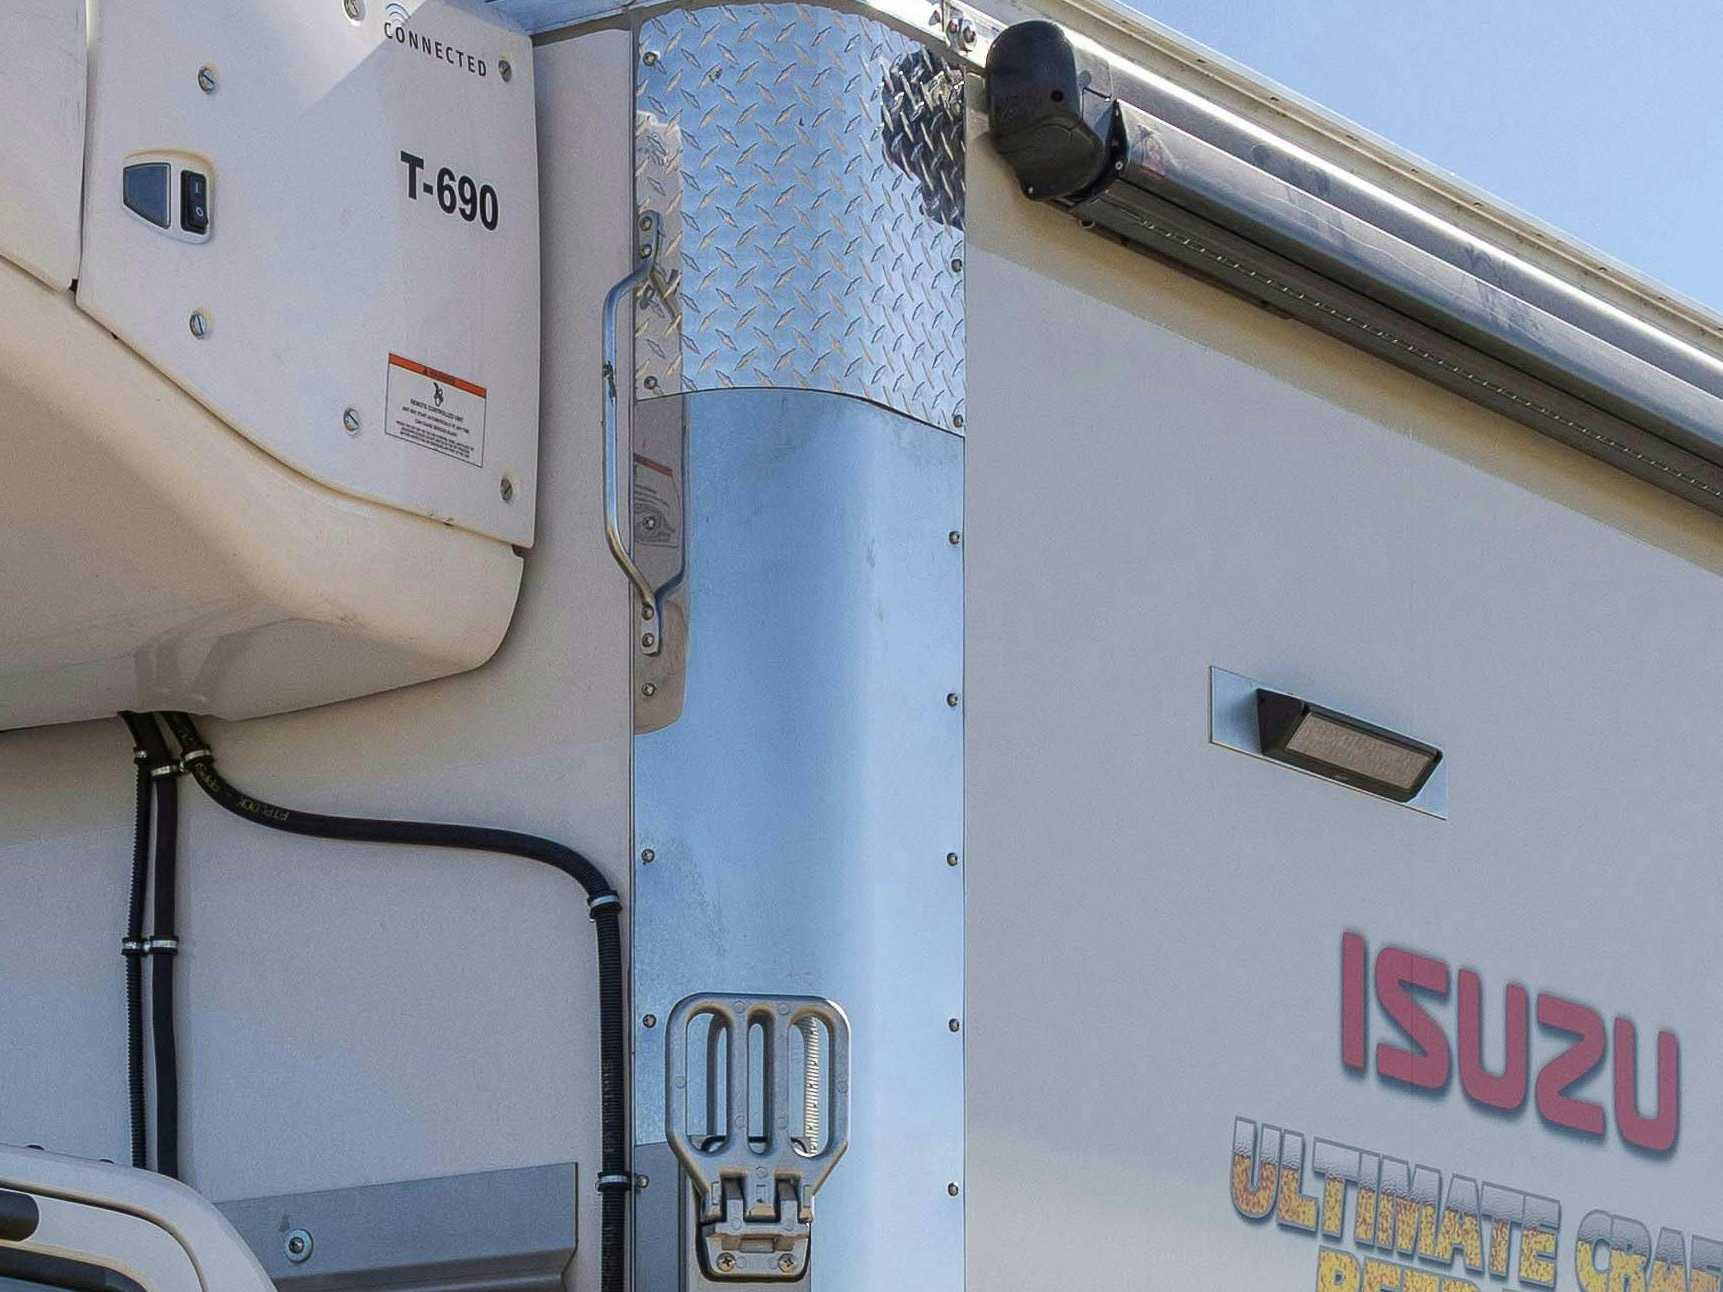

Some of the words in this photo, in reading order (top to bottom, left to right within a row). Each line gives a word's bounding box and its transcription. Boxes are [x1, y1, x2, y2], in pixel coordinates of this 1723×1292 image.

[383, 21, 489, 78] CONNECTED
[399, 150, 500, 233] T-690
[1341, 930, 1680, 1152] ISUZU
[1230, 1116, 1561, 1289] ULTIMATE
